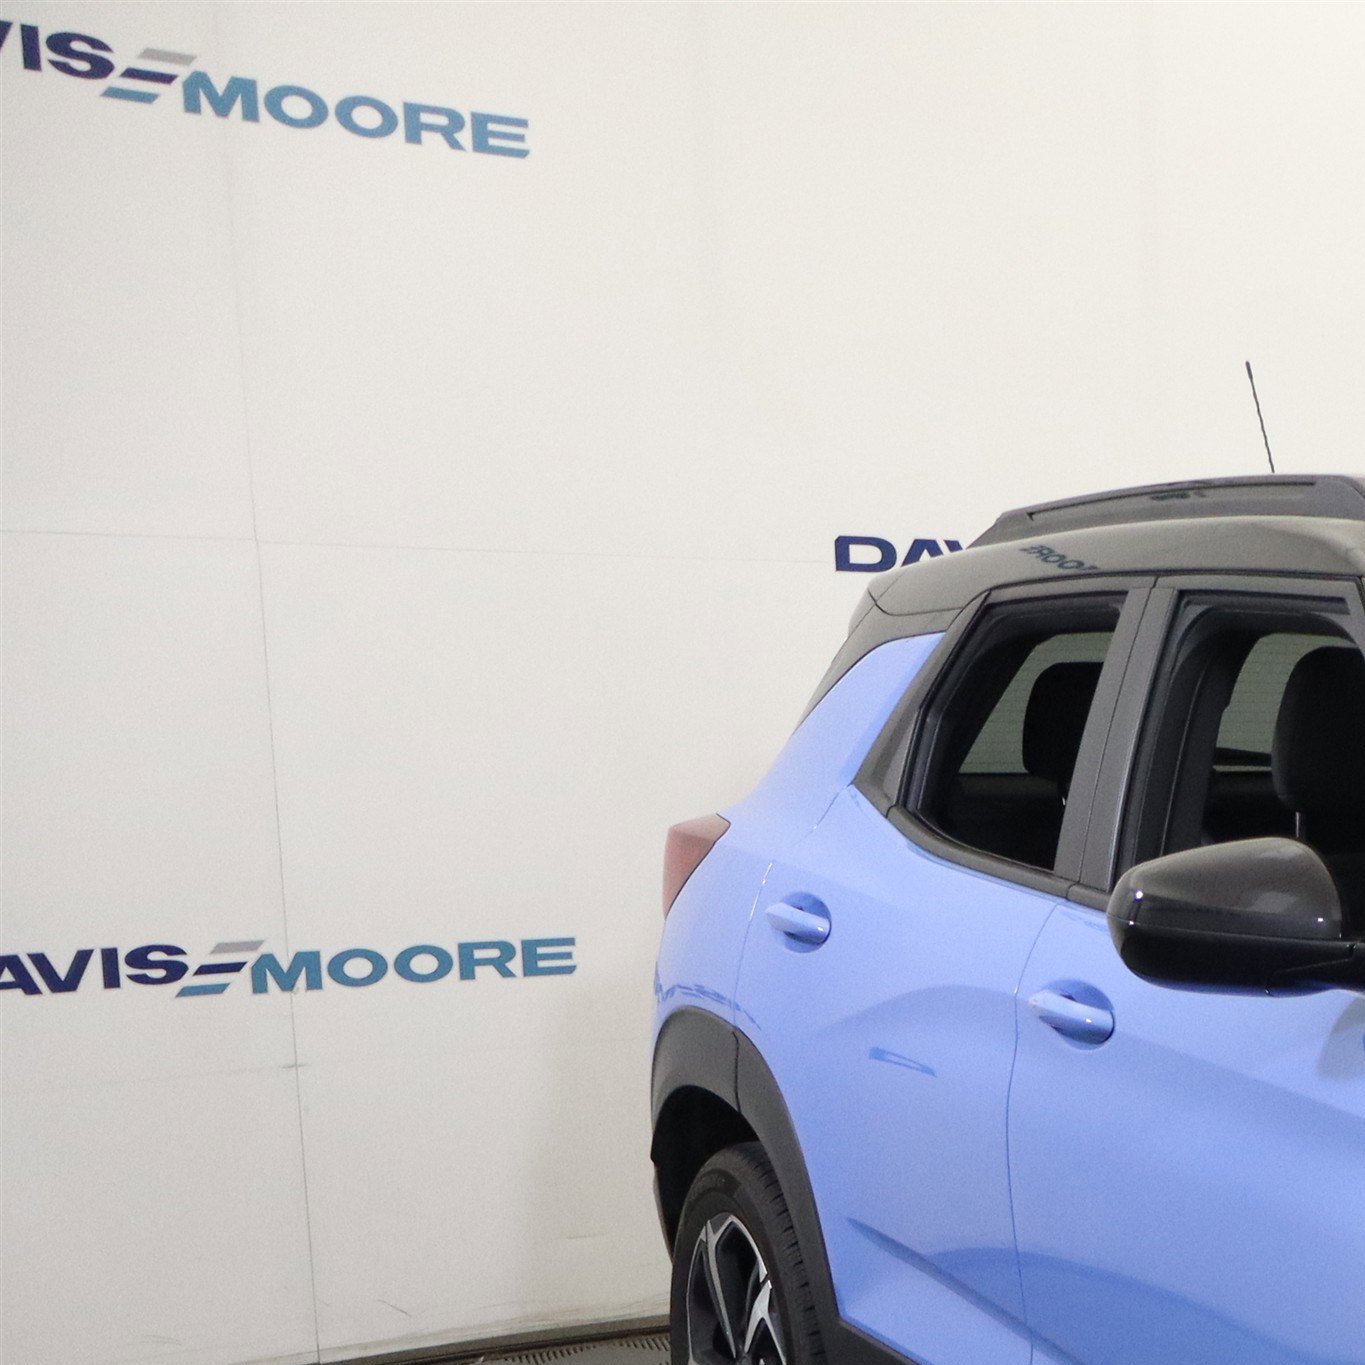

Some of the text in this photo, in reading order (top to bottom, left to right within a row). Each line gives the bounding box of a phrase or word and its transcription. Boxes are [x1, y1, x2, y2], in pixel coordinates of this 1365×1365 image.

[184, 71, 529, 158] MOORE
[835, 535, 960, 572] DA
[252, 936, 577, 994] MOORE
